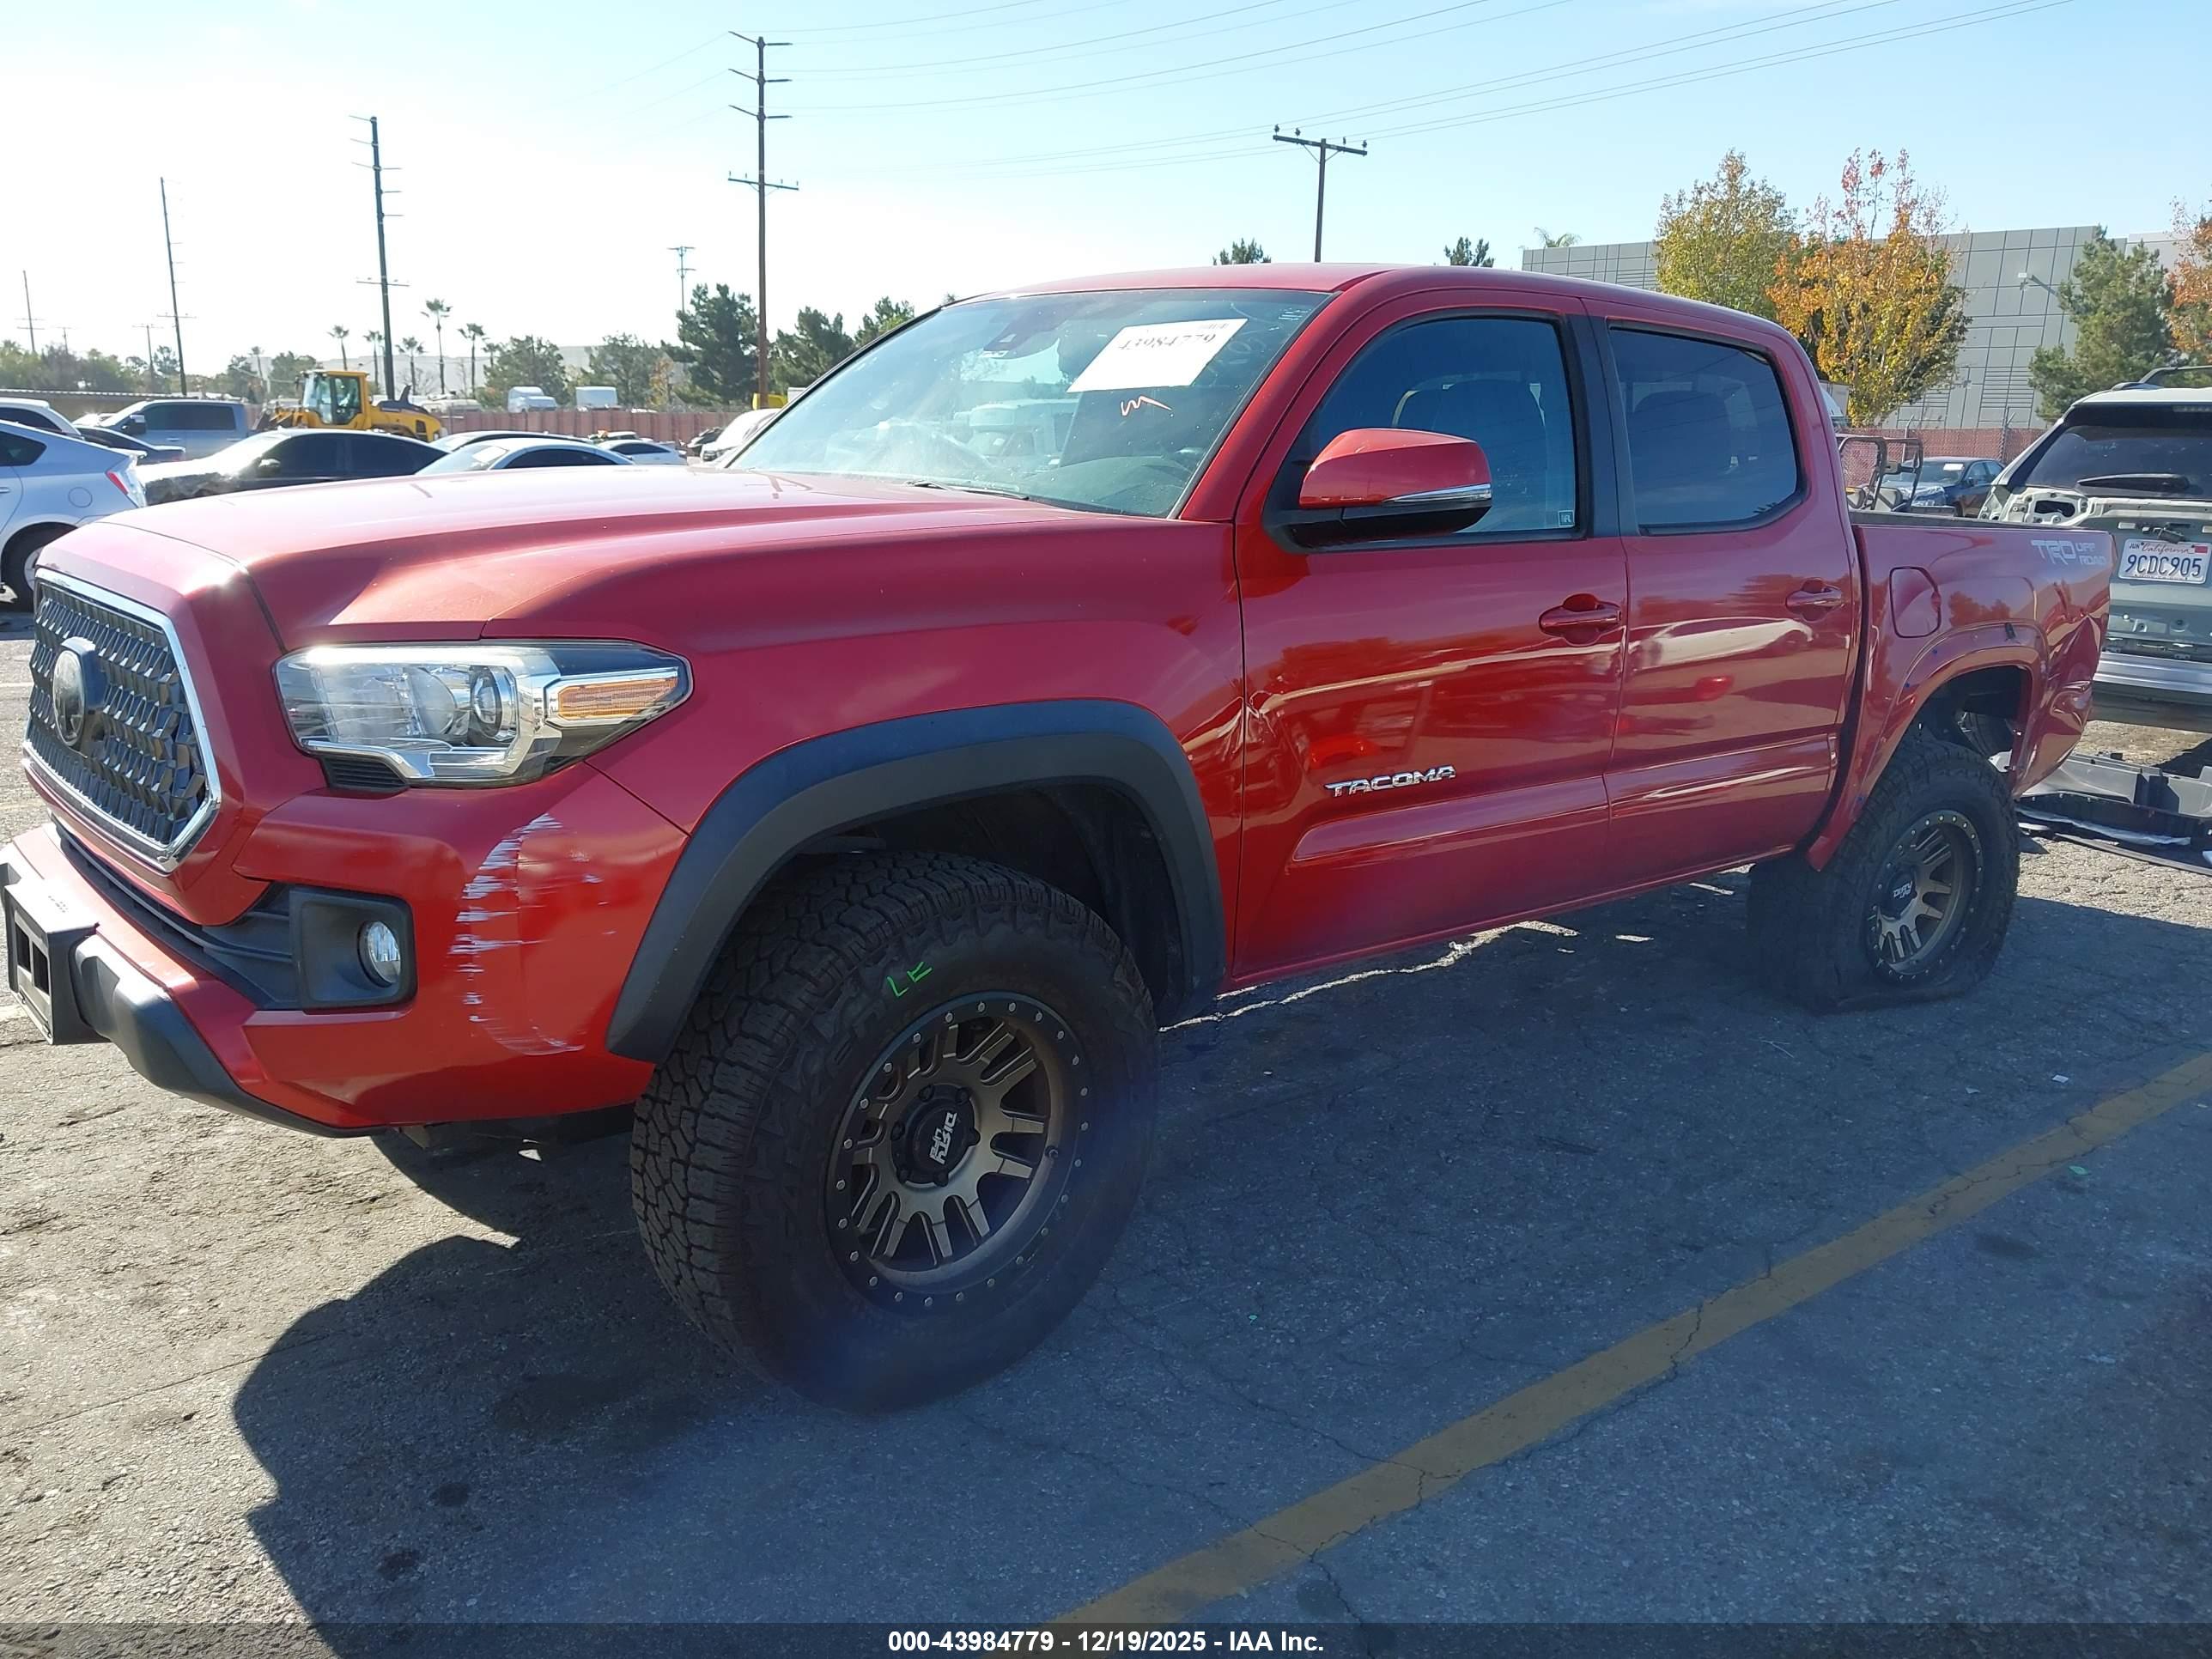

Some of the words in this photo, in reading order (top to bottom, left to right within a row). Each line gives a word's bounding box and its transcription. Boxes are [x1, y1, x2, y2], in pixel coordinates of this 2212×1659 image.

[2031, 539, 2077, 565] TRD
[2080, 556, 2107, 566] ROAD
[2142, 543, 2195, 556] California
[2125, 554, 2203, 578] 9CDC905
[1325, 764, 1456, 798] TACOMA
